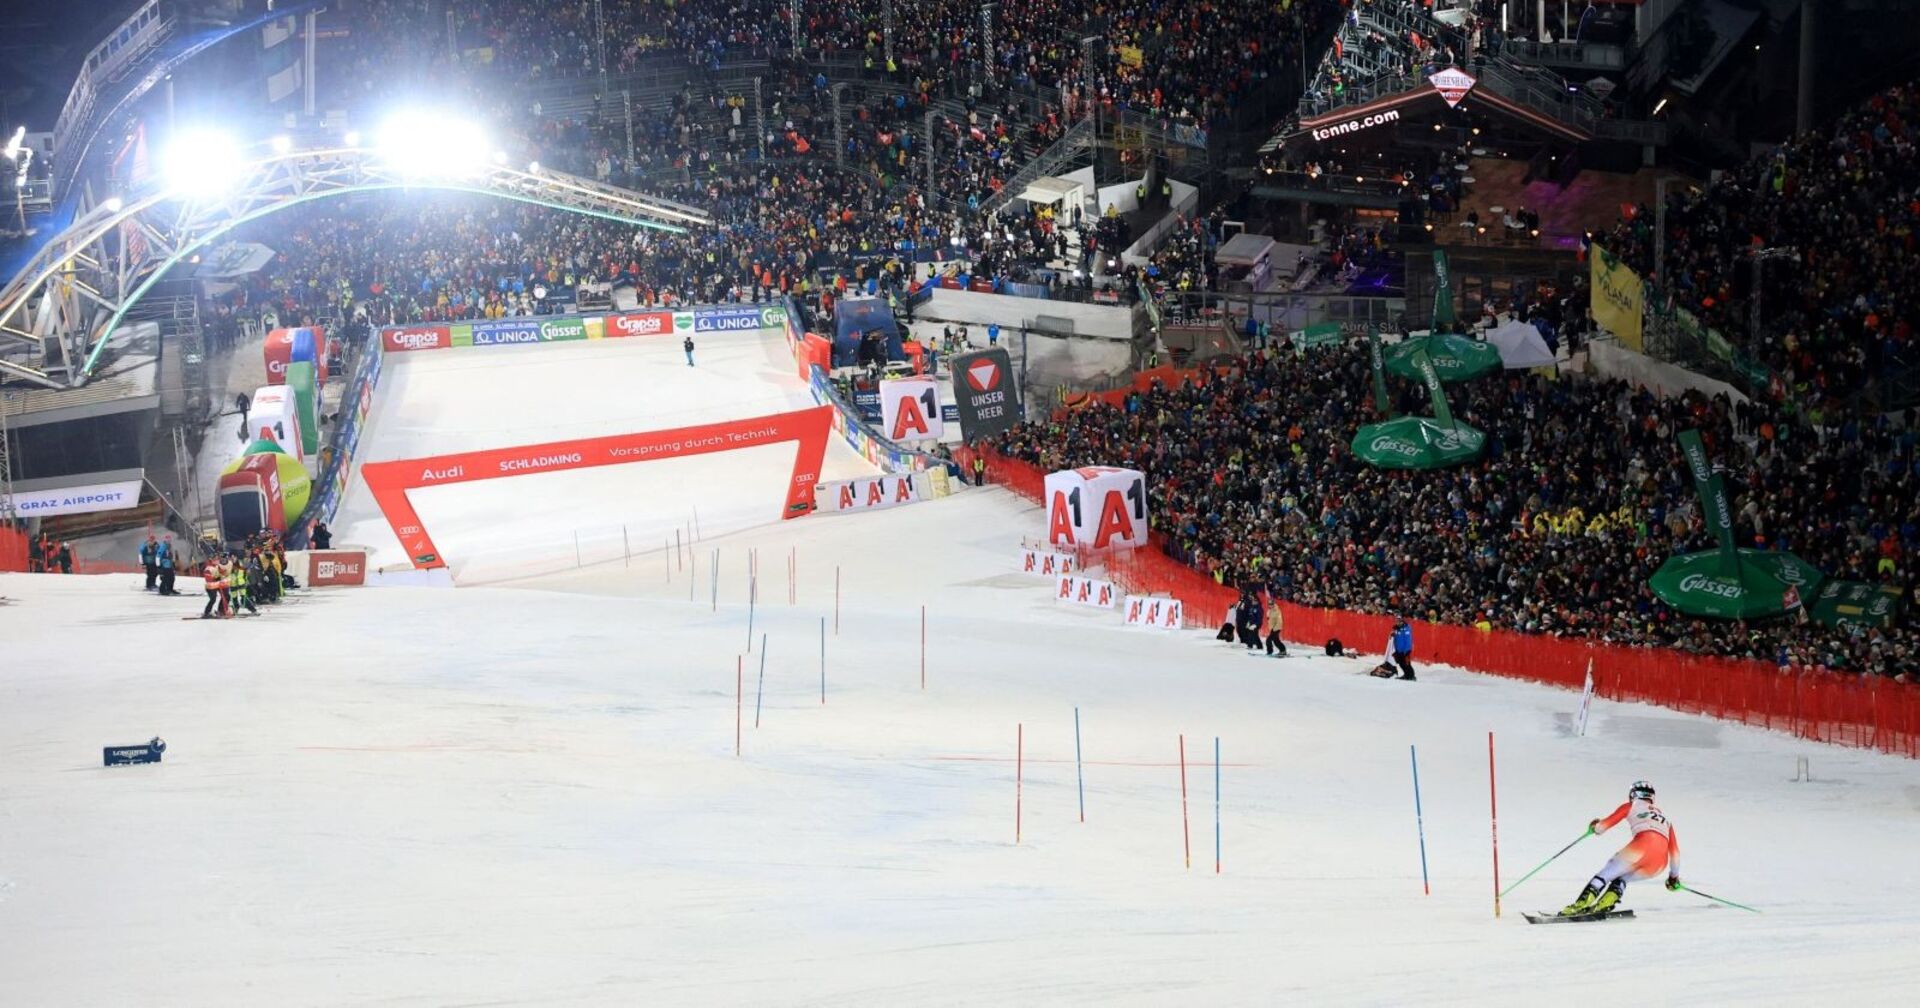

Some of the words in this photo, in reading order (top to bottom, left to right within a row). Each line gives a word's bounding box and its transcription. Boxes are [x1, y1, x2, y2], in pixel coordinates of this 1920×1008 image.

[1312, 110, 1400, 141] tenne.com
[540, 322, 584, 340] Gösser
[716, 318, 760, 329] UNIQA
[1378, 322, 1399, 333] Ski
[495, 331, 539, 342] UNIQA
[971, 391, 1005, 407] UNSER
[893, 387, 937, 440] A1
[977, 406, 1004, 421] HEER
[421, 465, 464, 481] Audi
[499, 452, 582, 472] SCHLADMING
[608, 441, 681, 457] Vorsprung
[684, 435, 724, 449] durch
[727, 426, 778, 443] Technik
[20, 500, 58, 511] GRAZ
[63, 492, 124, 507] AIRPORT
[840, 481, 856, 509] A1
[867, 477, 885, 506] A1
[895, 474, 913, 503] A1
[1050, 486, 1082, 545] A1
[1094, 478, 1144, 549] A1
[1024, 552, 1036, 572] A1
[1042, 554, 1055, 575] A1
[1059, 577, 1074, 599] A1
[1078, 580, 1092, 602] A1
[1098, 583, 1112, 606] A1
[1680, 573, 1748, 599] Gösser
[1128, 599, 1143, 623] A1
[1145, 600, 1160, 625] A1
[1165, 602, 1180, 628] A1
[1649, 811, 1666, 824] 27
